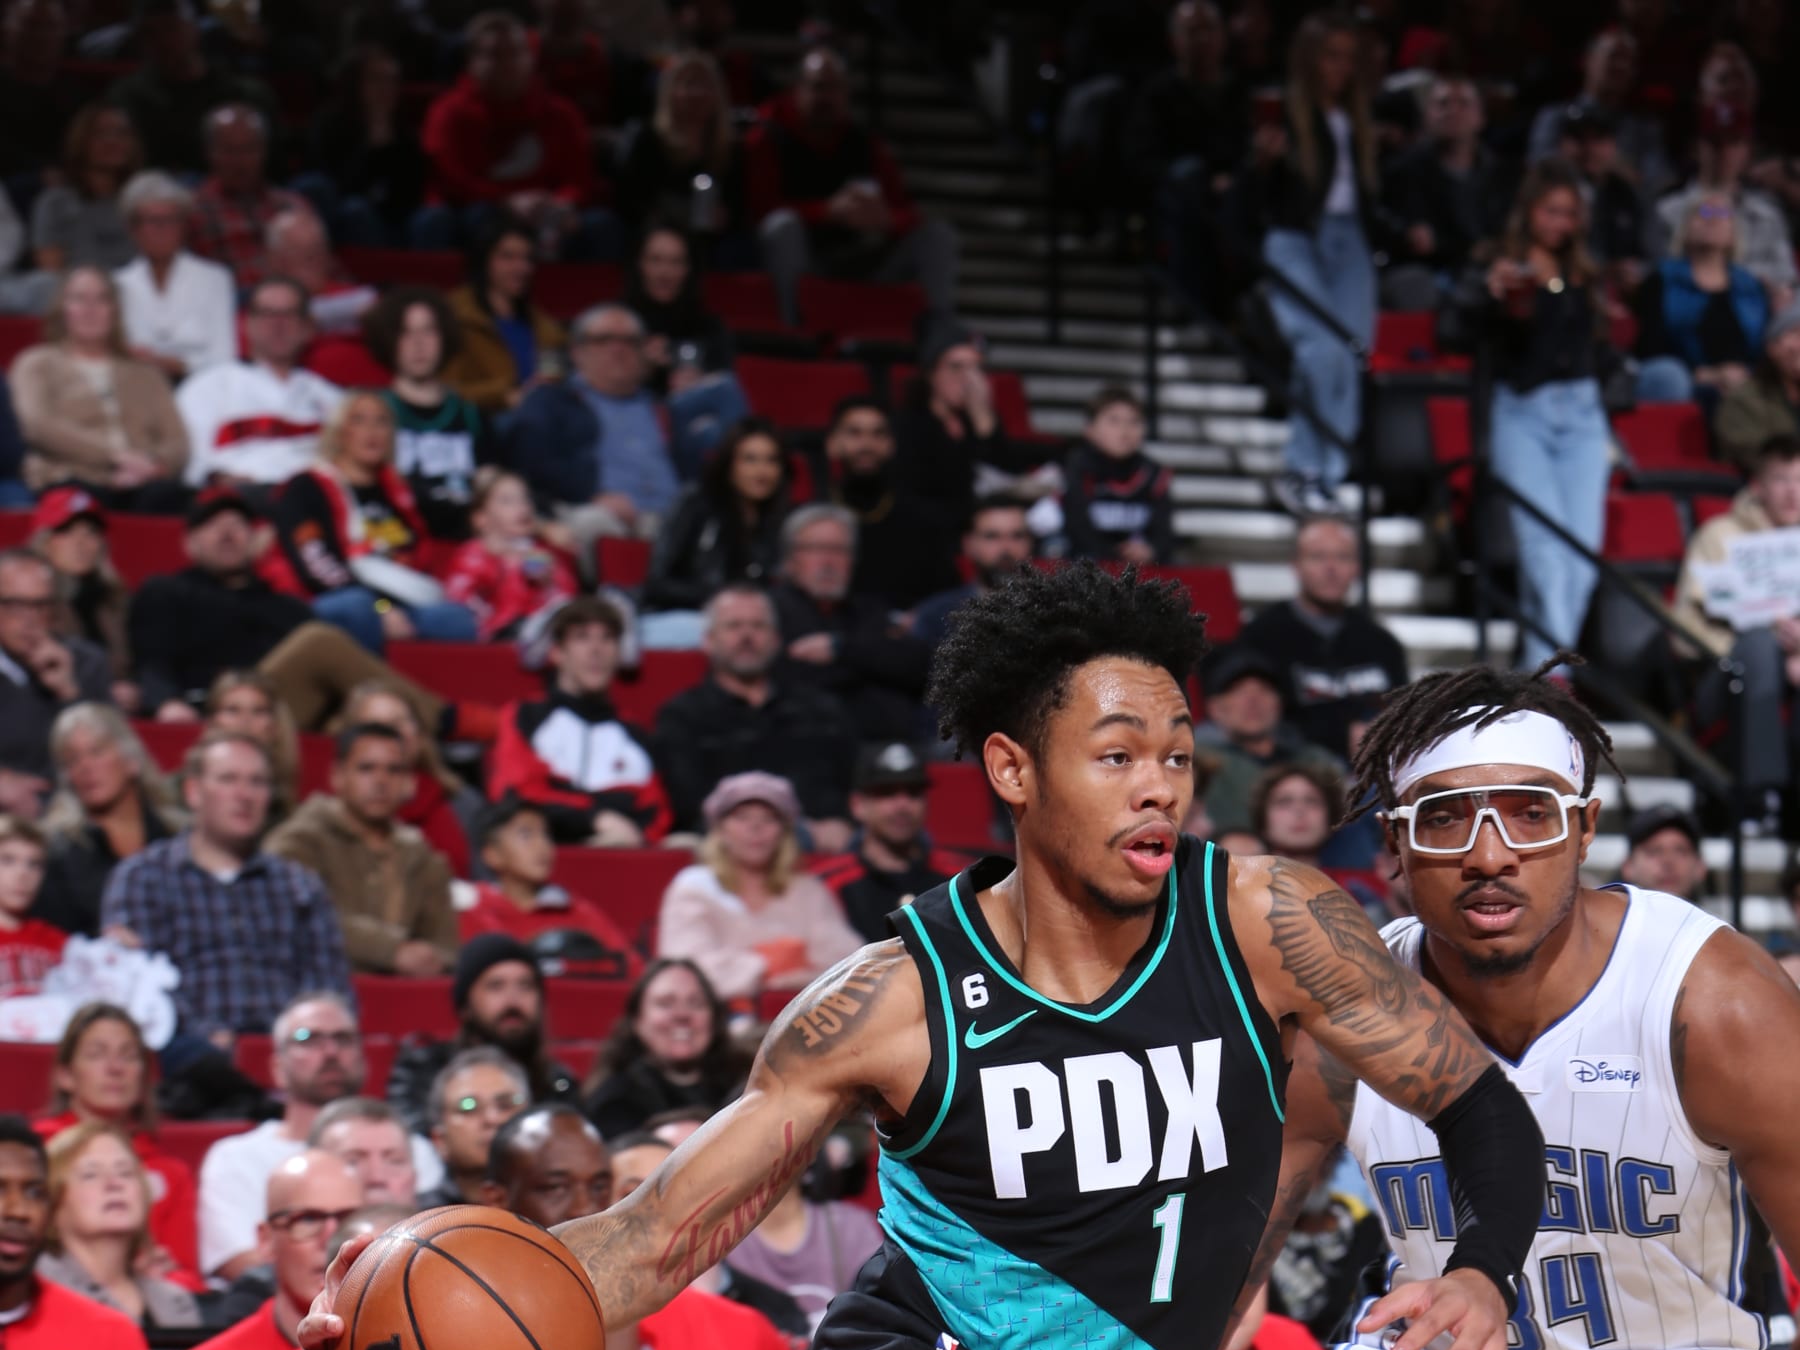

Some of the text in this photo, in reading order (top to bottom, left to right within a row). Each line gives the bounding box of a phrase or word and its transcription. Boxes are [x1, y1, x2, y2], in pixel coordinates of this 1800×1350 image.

[961, 972, 990, 1009] 6
[979, 1037, 1229, 1200] PDX
[1569, 1059, 1641, 1089] Disney
[1369, 1144, 1681, 1242] MGIC
[1149, 1192, 1186, 1303] 1
